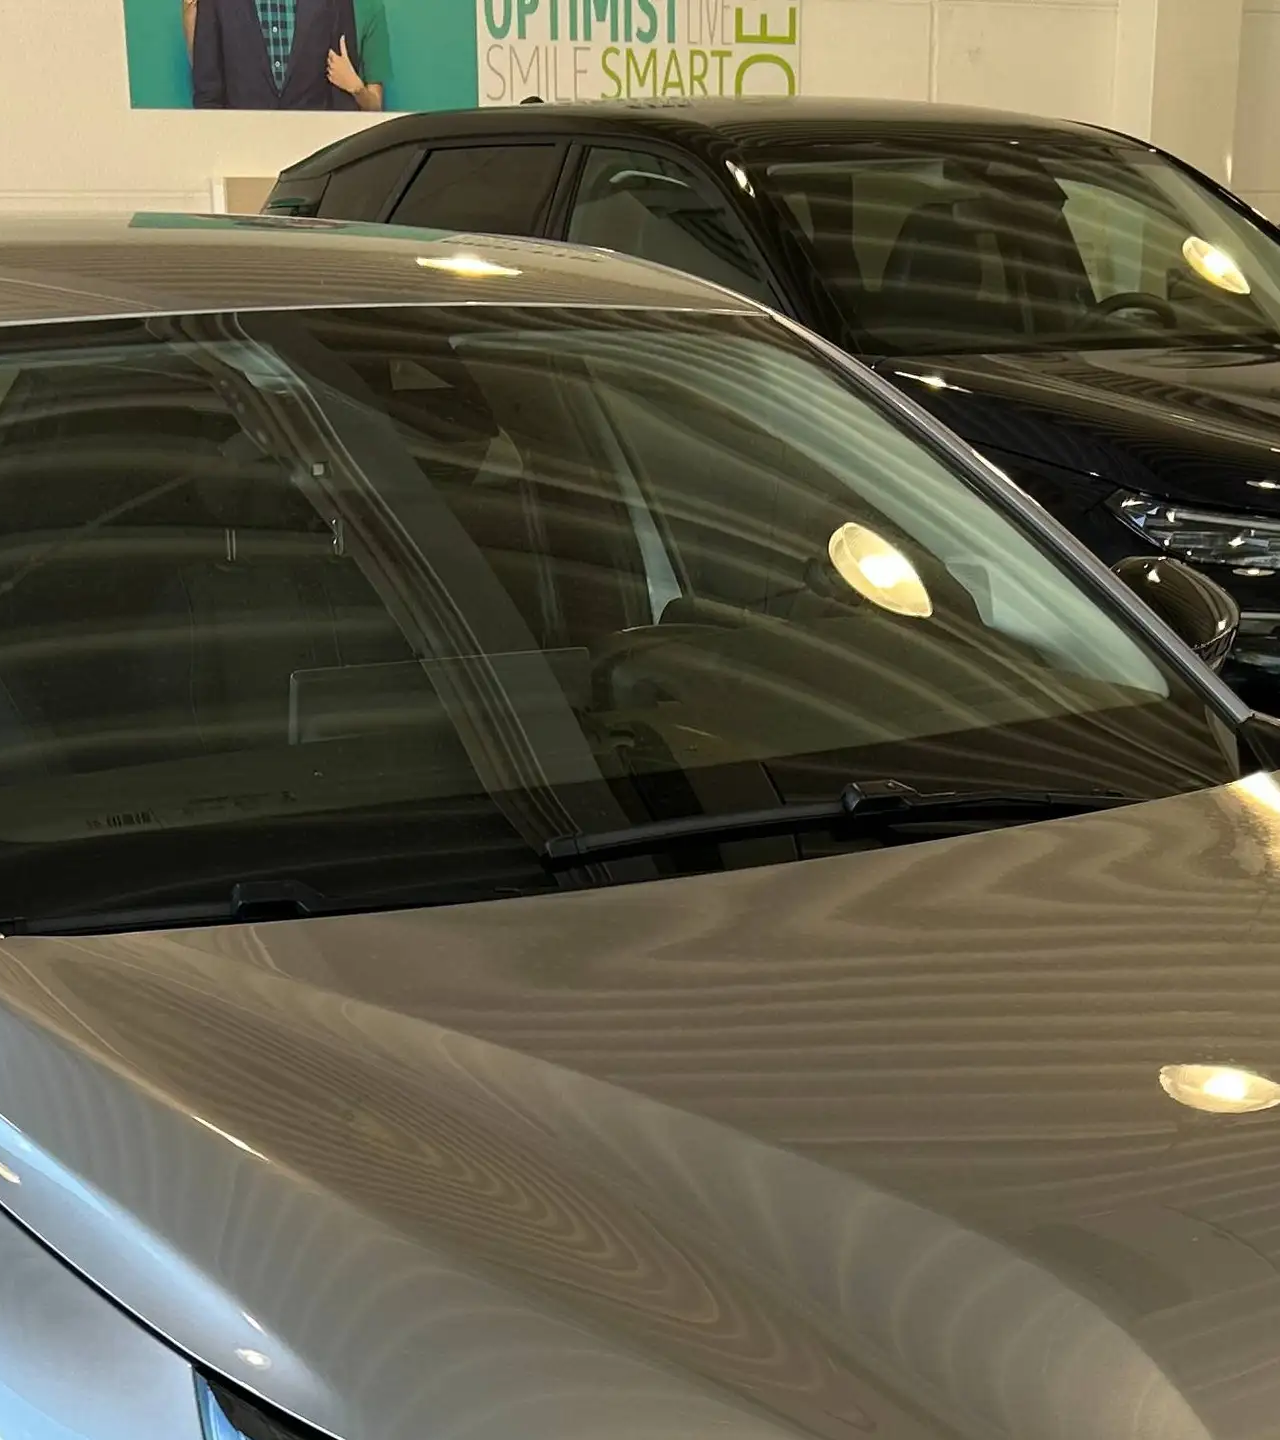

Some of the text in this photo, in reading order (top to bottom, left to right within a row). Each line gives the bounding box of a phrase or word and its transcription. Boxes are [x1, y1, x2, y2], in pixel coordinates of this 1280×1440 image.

[484, 0, 733, 45] OPTIMIST LIVE
[486, 44, 733, 102] SMILE SMART
